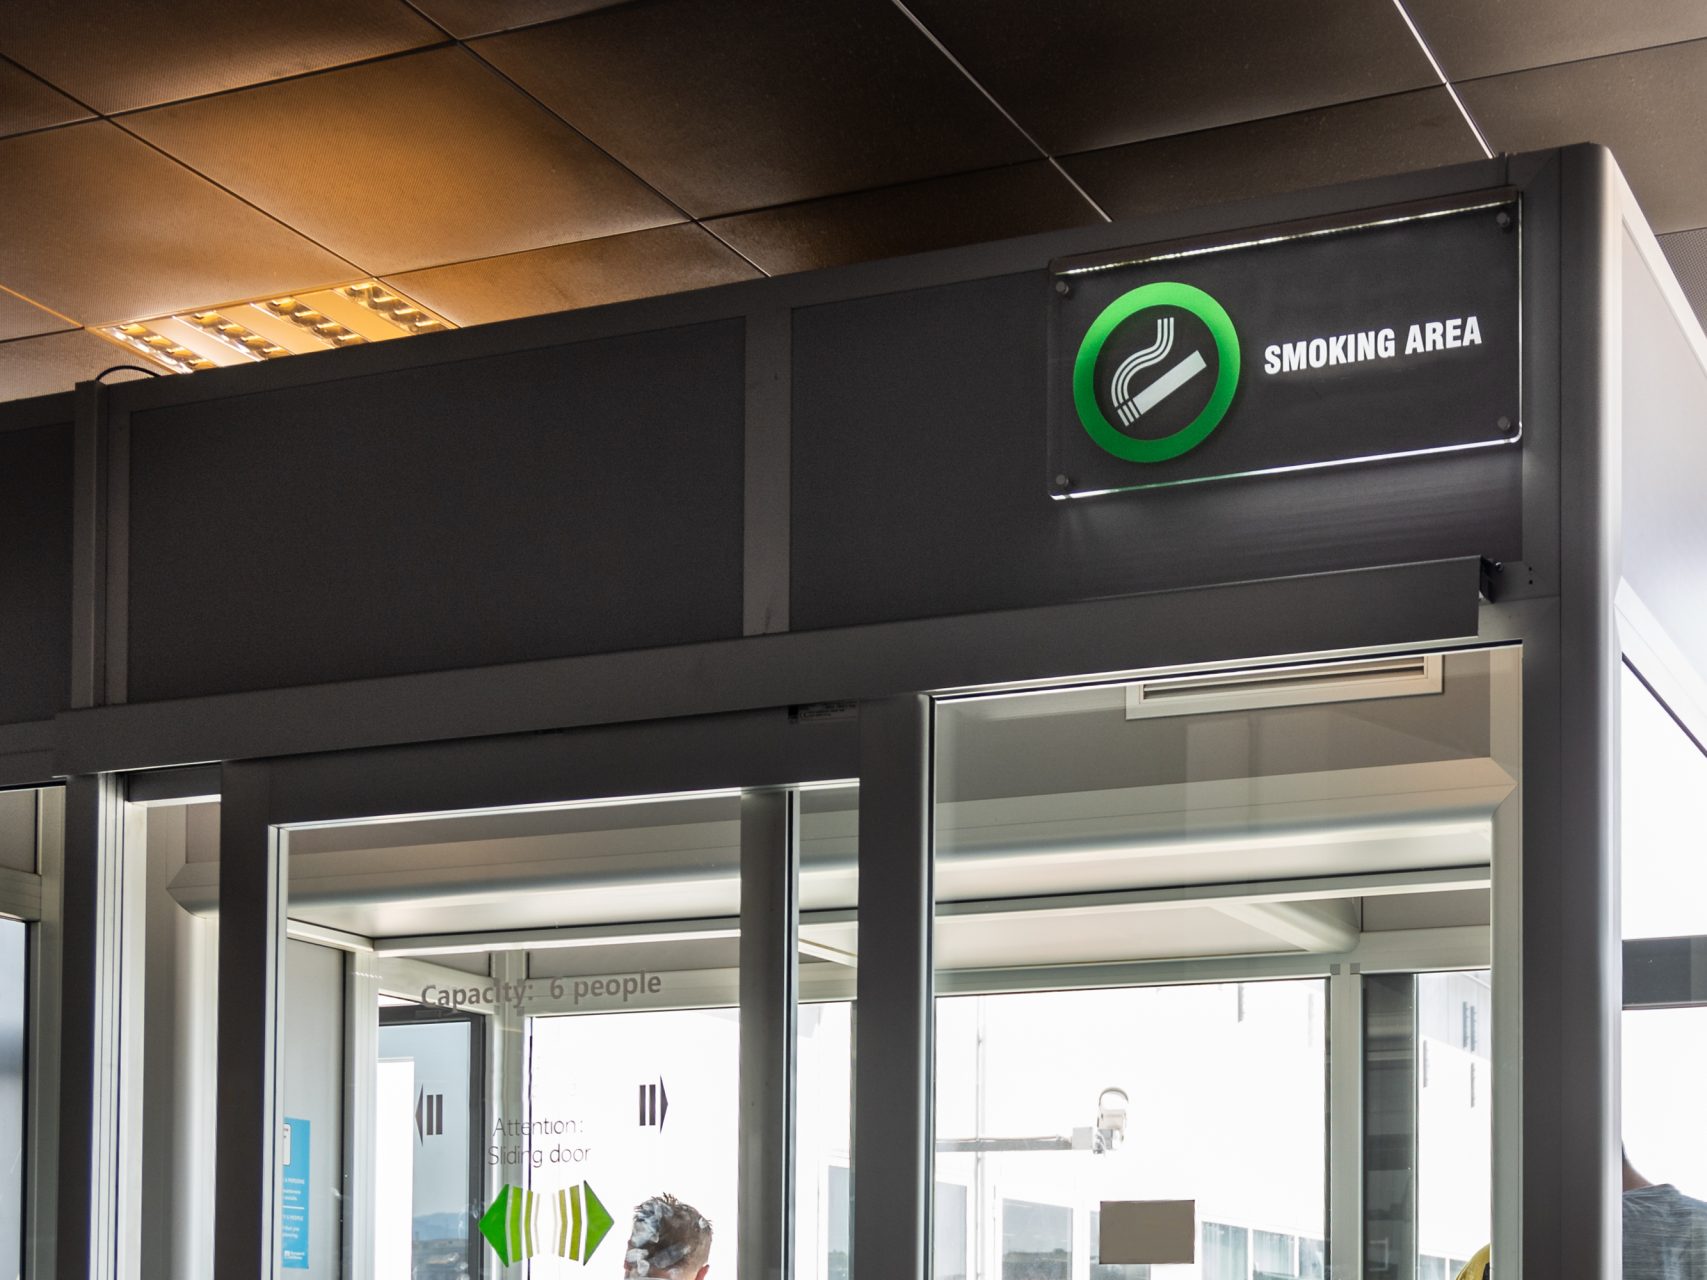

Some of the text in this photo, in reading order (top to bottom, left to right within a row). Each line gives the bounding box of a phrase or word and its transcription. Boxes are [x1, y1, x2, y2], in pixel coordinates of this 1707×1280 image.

[1264, 316, 1483, 375] SMOKING AREA
[549, 976, 564, 1000] 6
[573, 970, 662, 1004] people
[487, 1143, 591, 1169] Sliding door
